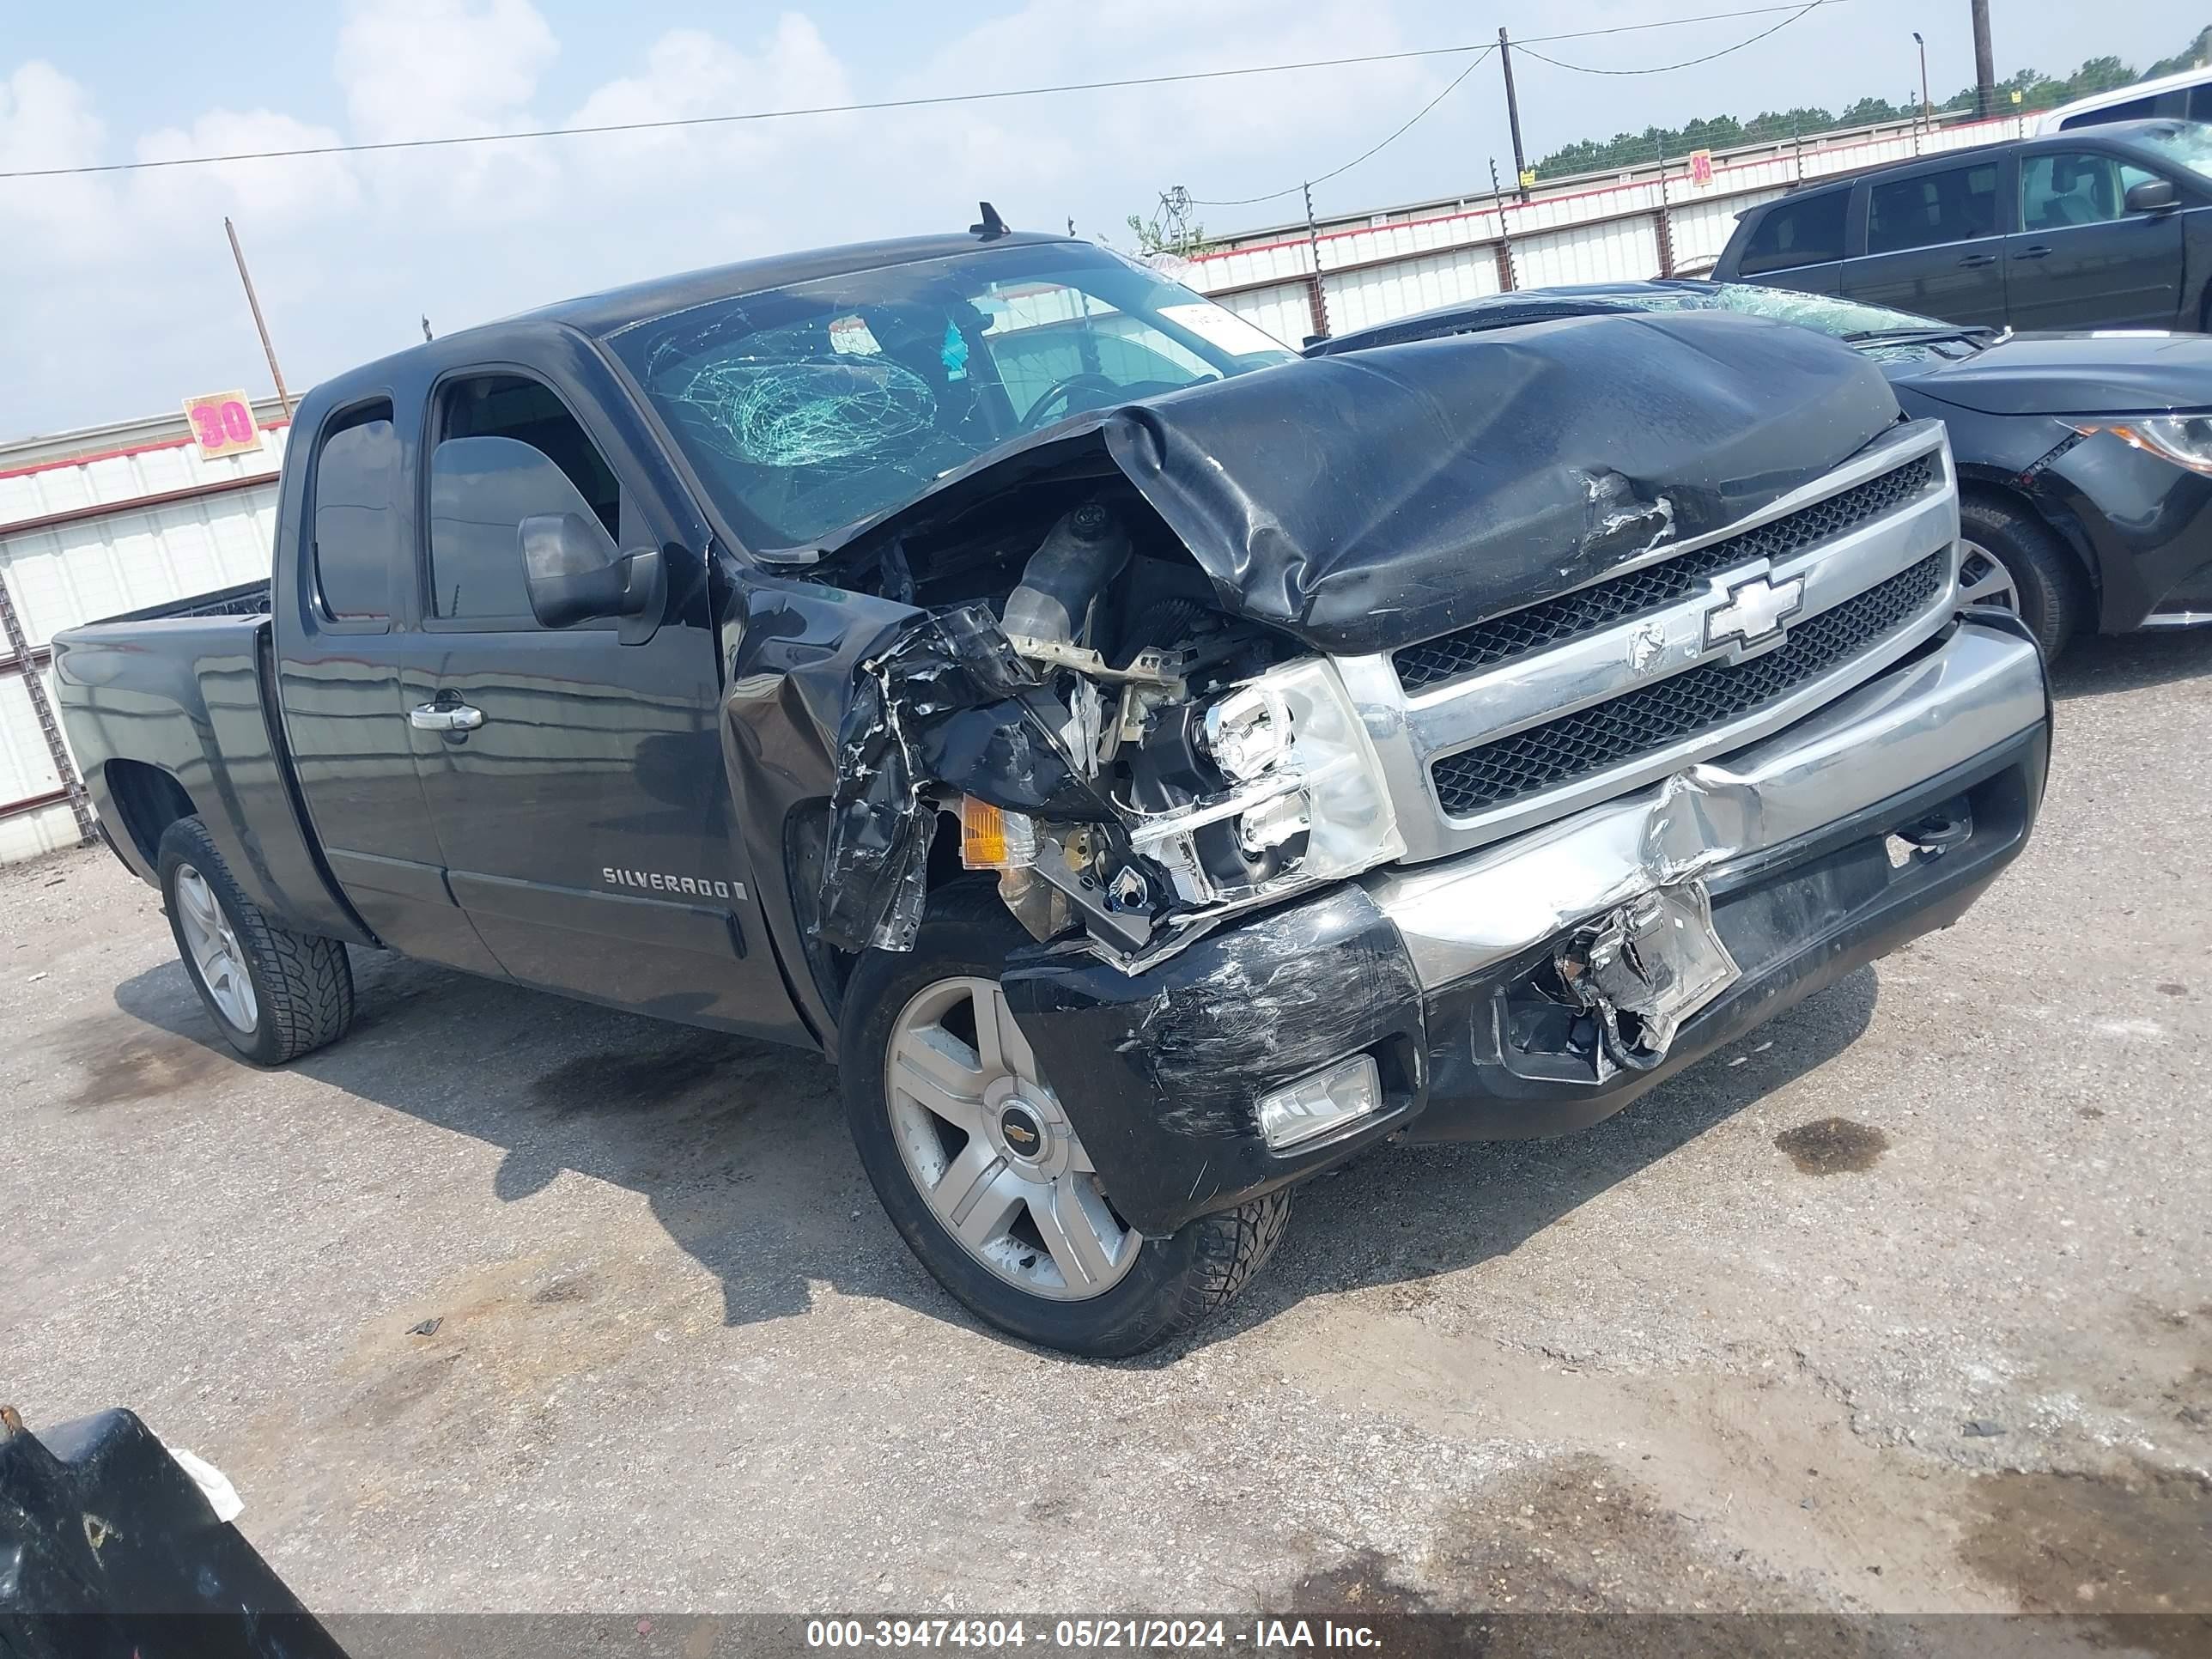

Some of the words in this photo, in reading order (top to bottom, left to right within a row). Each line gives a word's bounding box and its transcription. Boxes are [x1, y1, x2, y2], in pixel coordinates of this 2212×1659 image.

[1692, 155, 1711, 180] 35
[191, 400, 253, 448] 30
[602, 866, 730, 899] SILVERADO
